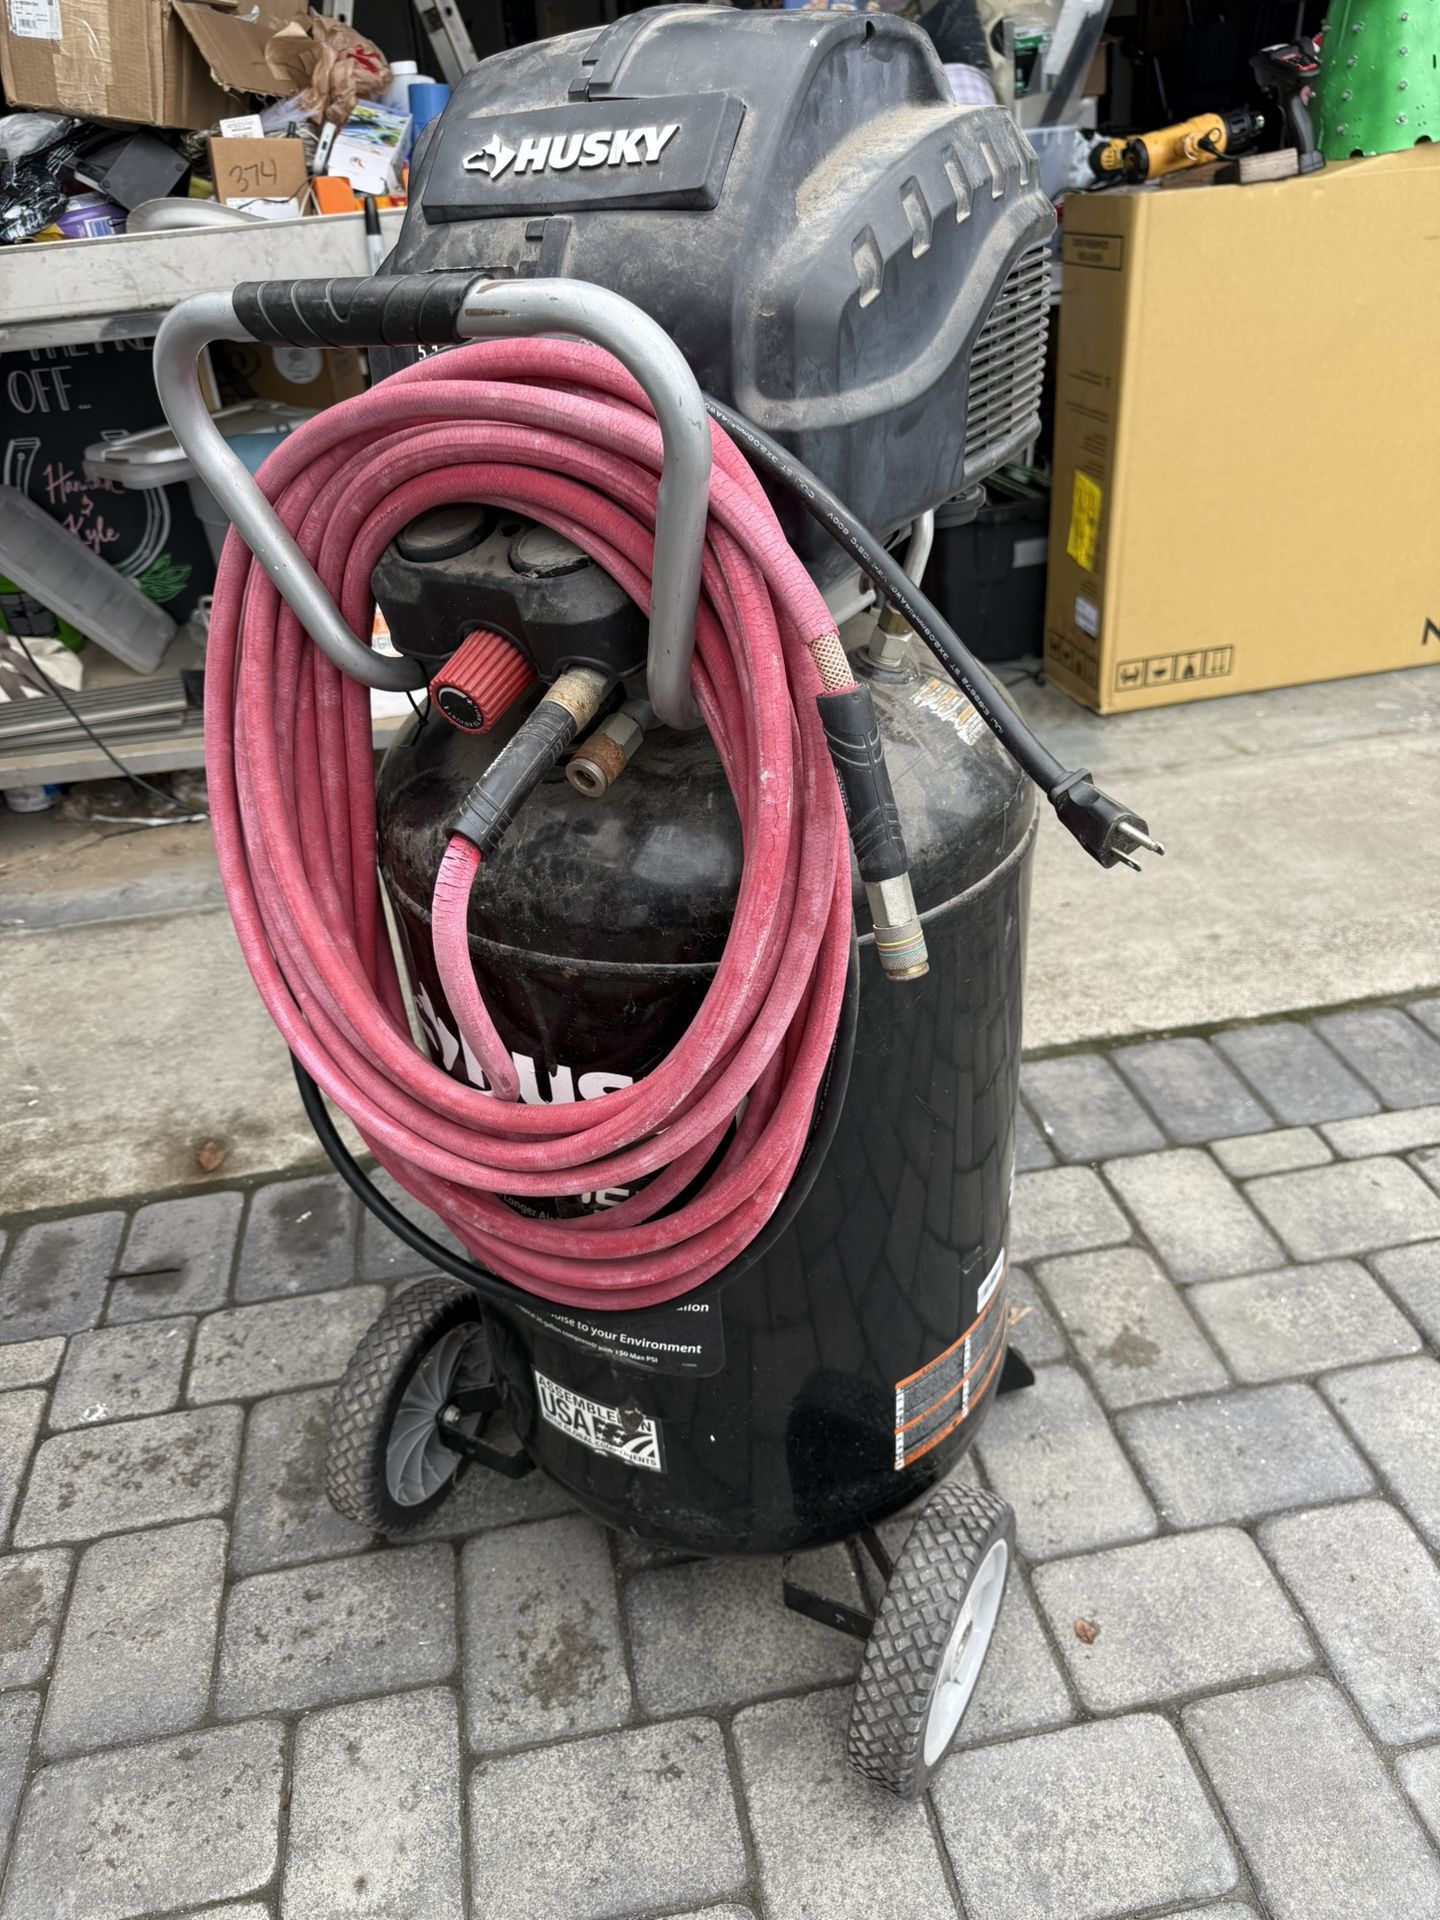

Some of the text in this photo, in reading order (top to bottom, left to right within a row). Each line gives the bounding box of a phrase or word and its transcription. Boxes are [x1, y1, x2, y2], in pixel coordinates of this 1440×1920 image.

[514, 124, 680, 174] HUSKY
[229, 158, 277, 192] 374
[827, 512, 850, 535] 600V
[577, 1321, 589, 1332] to
[590, 1326, 618, 1341] your
[620, 1333, 702, 1354] Environment
[615, 1349, 629, 1358] 150
[646, 1355, 659, 1363] PSI
[539, 1376, 622, 1425] ASSEMBLE
[540, 1385, 592, 1437] USA
